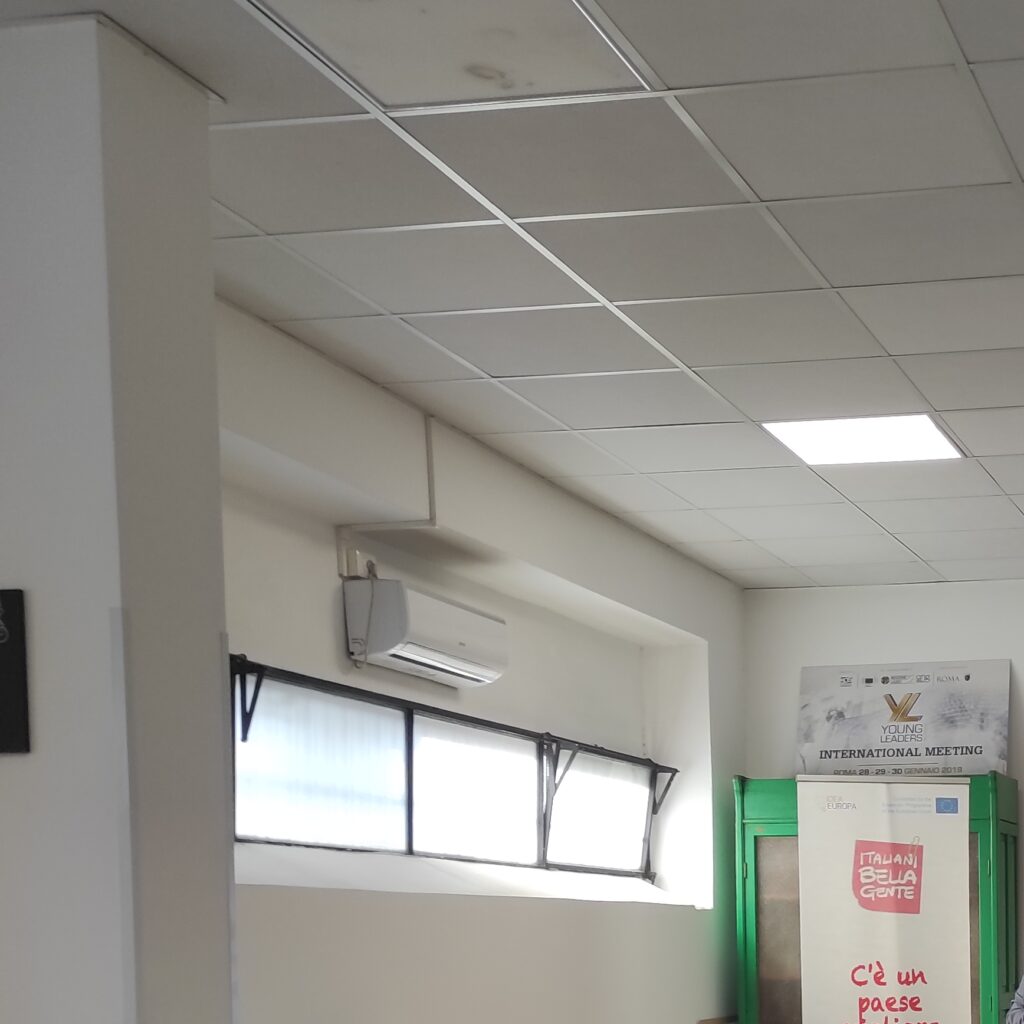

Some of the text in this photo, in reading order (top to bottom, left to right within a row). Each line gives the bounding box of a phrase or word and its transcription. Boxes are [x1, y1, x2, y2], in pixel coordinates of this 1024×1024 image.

[881, 724, 923, 735] YOUNG
[880, 734, 923, 743] LEADERS
[819, 745, 983, 760] INTERNATIONAL MEETING
[904, 767, 940, 775] GENNAIO
[827, 802, 857, 810] EUROPA
[860, 851, 918, 868] ITALIANI
[858, 866, 917, 884] BELLA
[859, 884, 915, 900] GENTE
[851, 961, 928, 987] C'è un
[858, 995, 923, 1024] paese
